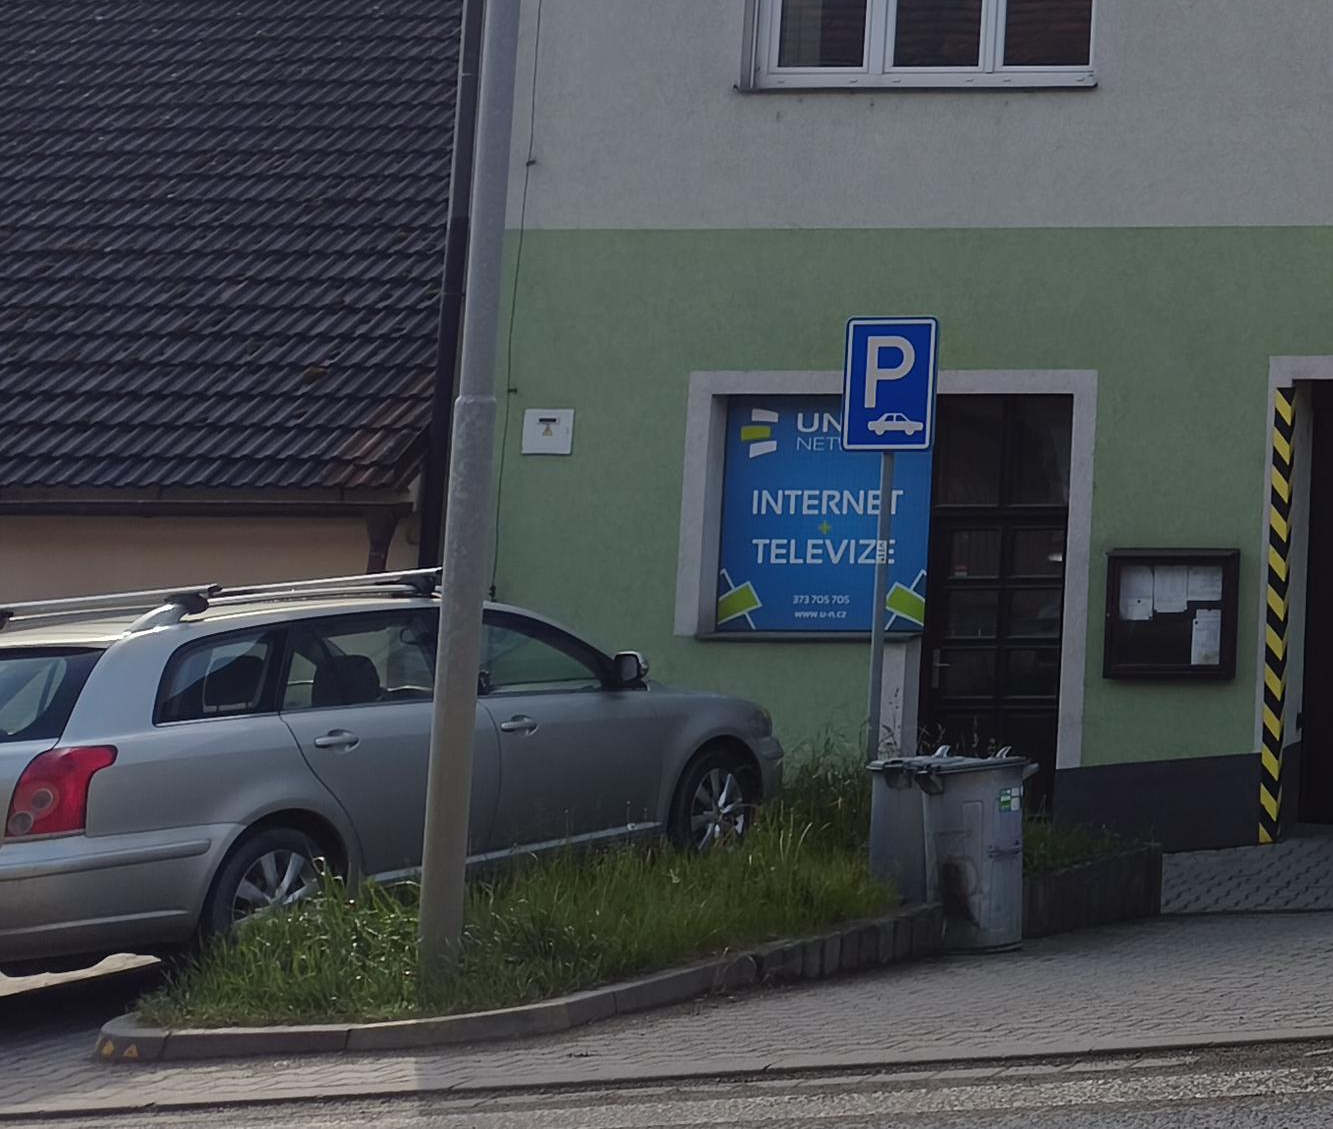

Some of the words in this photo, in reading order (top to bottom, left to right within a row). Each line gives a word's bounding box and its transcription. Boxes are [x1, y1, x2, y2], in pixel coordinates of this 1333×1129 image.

[864, 335, 916, 409] P
[752, 489, 904, 516] INTERNET
[792, 594, 810, 605] 373
[811, 594, 830, 605] 705
[832, 594, 850, 605] 705
